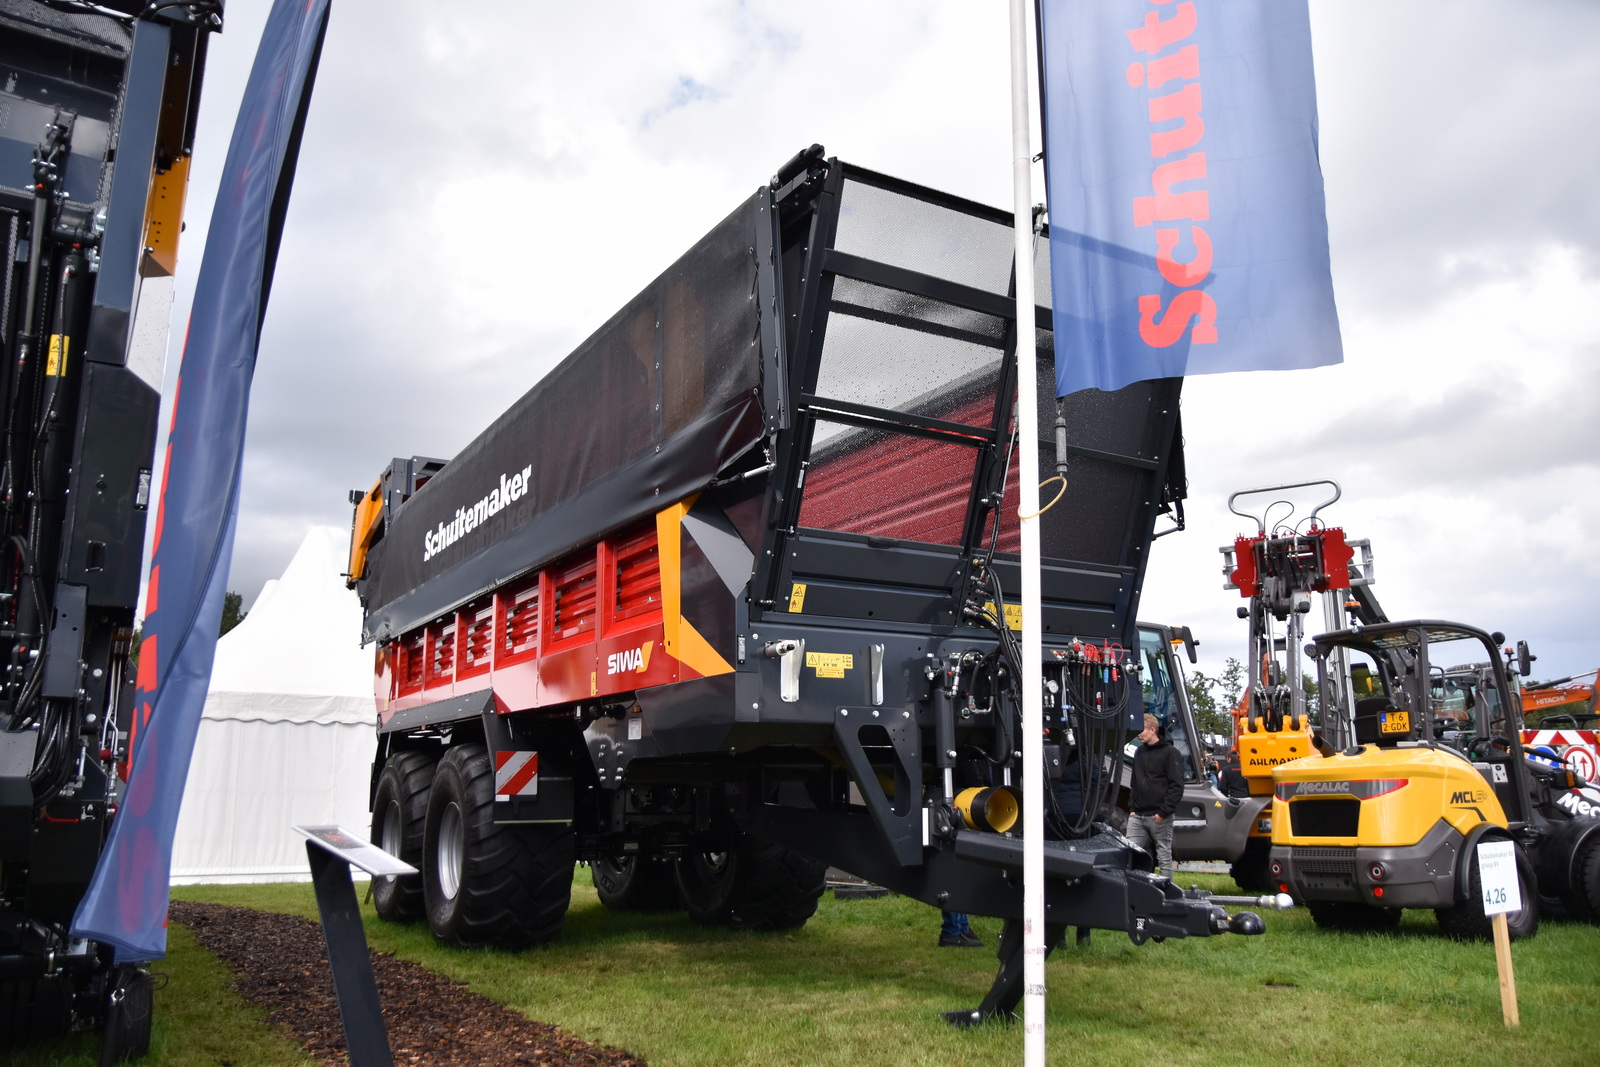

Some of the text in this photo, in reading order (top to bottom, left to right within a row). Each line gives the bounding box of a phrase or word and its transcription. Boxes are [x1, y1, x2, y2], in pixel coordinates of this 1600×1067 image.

[1126, 0, 1218, 347] Schuit
[423, 464, 532, 562] Schuitemaker
[607, 647, 644, 675] SIWA
[1536, 695, 1566, 706] HITACHI
[1485, 887, 1507, 905] 4.26
